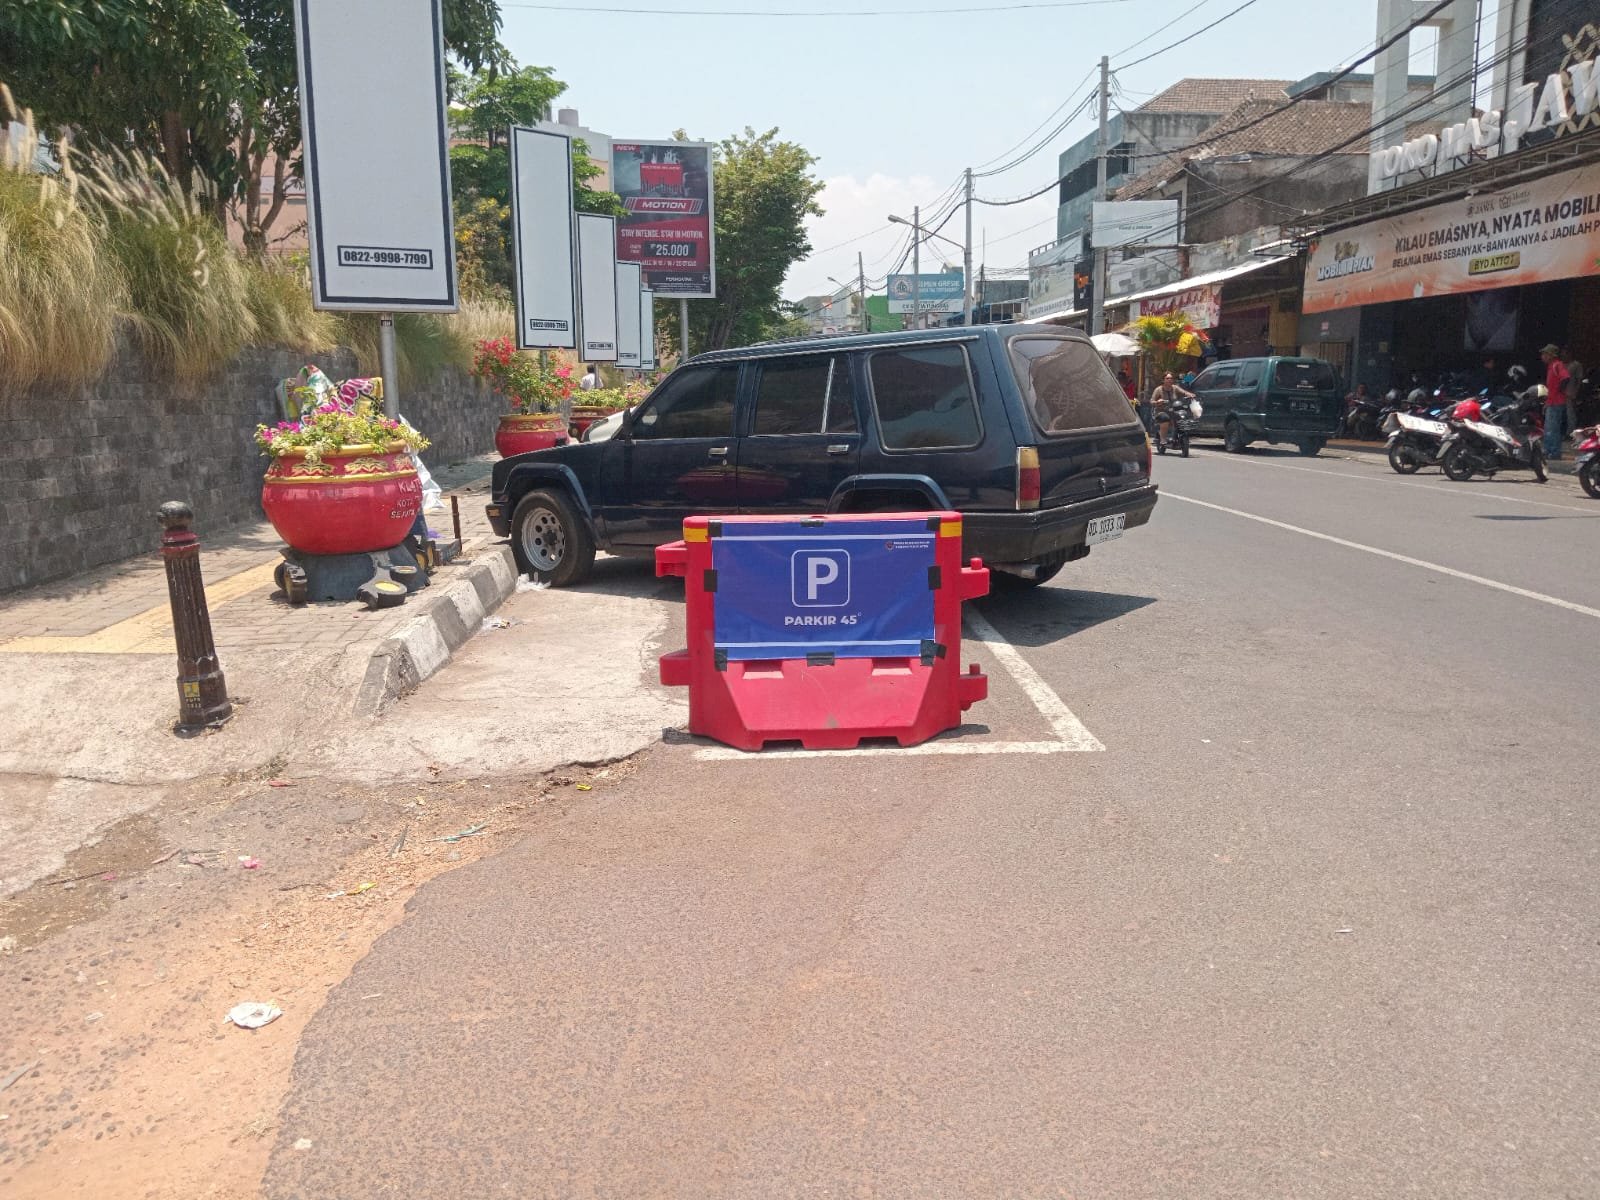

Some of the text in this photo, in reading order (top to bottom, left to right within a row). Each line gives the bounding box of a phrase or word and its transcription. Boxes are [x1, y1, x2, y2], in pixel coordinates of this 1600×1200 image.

[1369, 134, 1438, 181] TOKO
[1440, 110, 1501, 157] MAS
[642, 201, 687, 209] MOTION
[621, 229, 634, 237] STAY
[661, 230, 675, 238] STAY
[1395, 233, 1427, 254] KILAU
[1428, 221, 1490, 247] EMASNYA,
[1493, 208, 1541, 234] NYATA
[656, 244, 688, 256] 25.000
[1392, 256, 1421, 268] BELANJA
[1423, 251, 1442, 263] EMAS
[1443, 232, 1539, 259] SEBANYAK-BANYAKNYA
[1541, 230, 1549, 242] &
[1550, 222, 1591, 240] JADILAH
[343, 251, 427, 264] 0822-9998-7799
[807, 557, 839, 600] P
[784, 615, 837, 626] PARKIR
